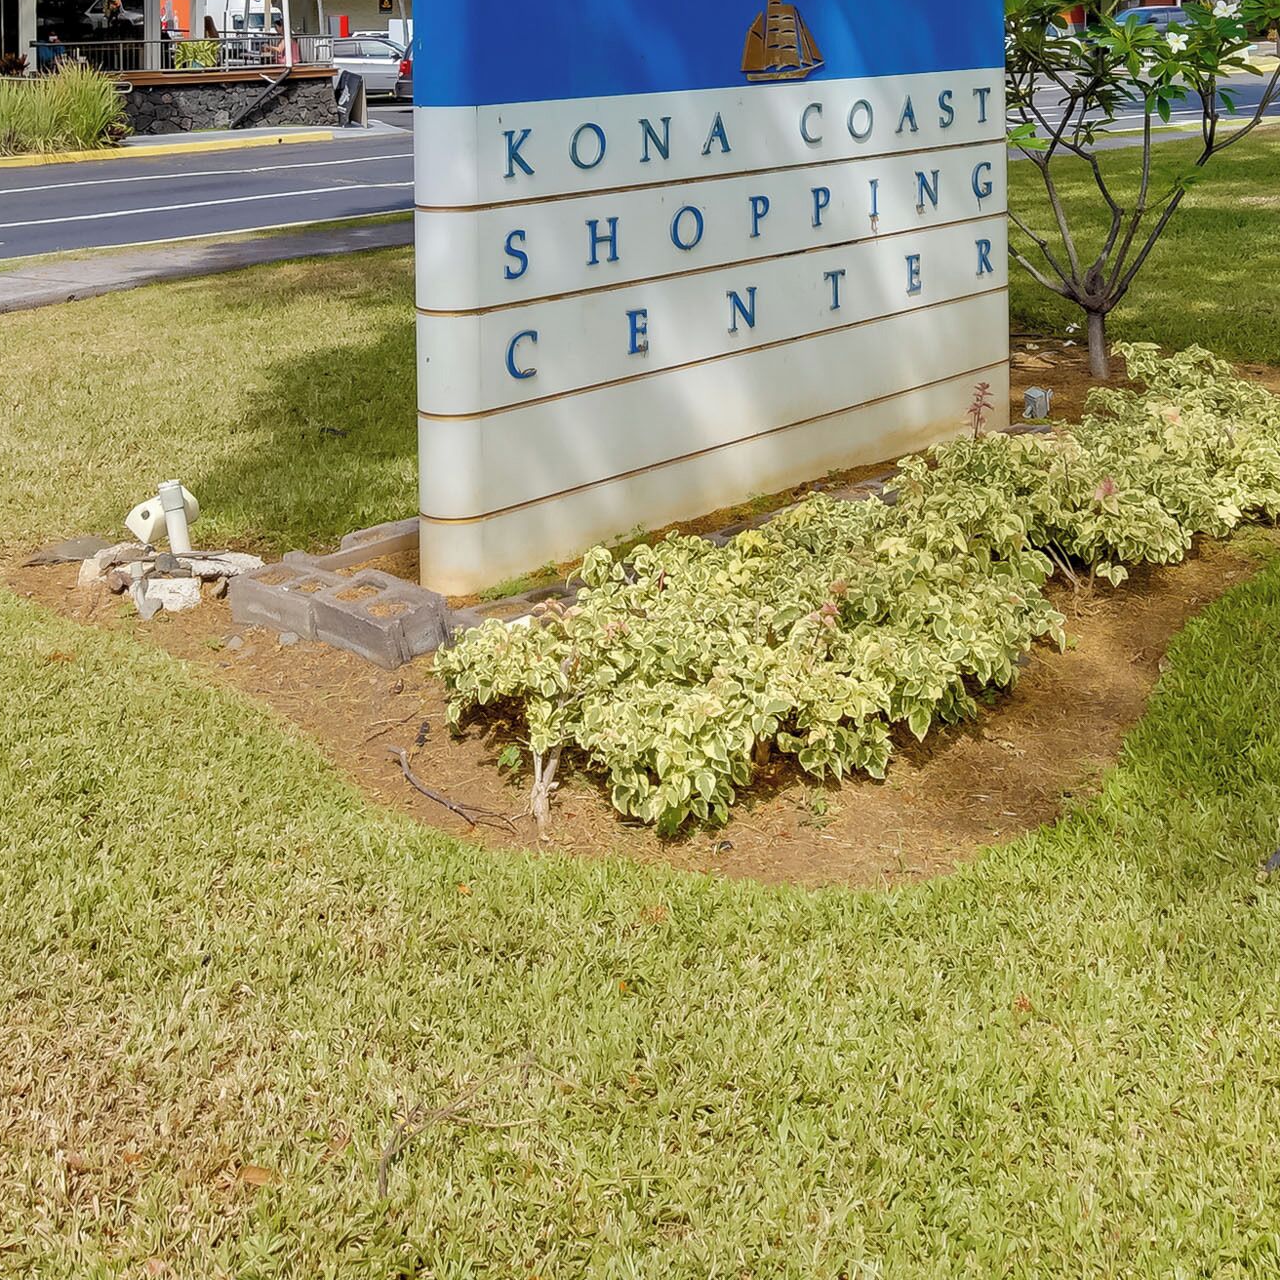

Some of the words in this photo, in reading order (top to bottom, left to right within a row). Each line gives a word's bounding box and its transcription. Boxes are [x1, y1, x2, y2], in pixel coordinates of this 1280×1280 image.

[502, 111, 732, 179] KONA
[798, 86, 991, 145] COAST
[503, 161, 994, 280] SHOPPING
[504, 238, 995, 380] CENTER
